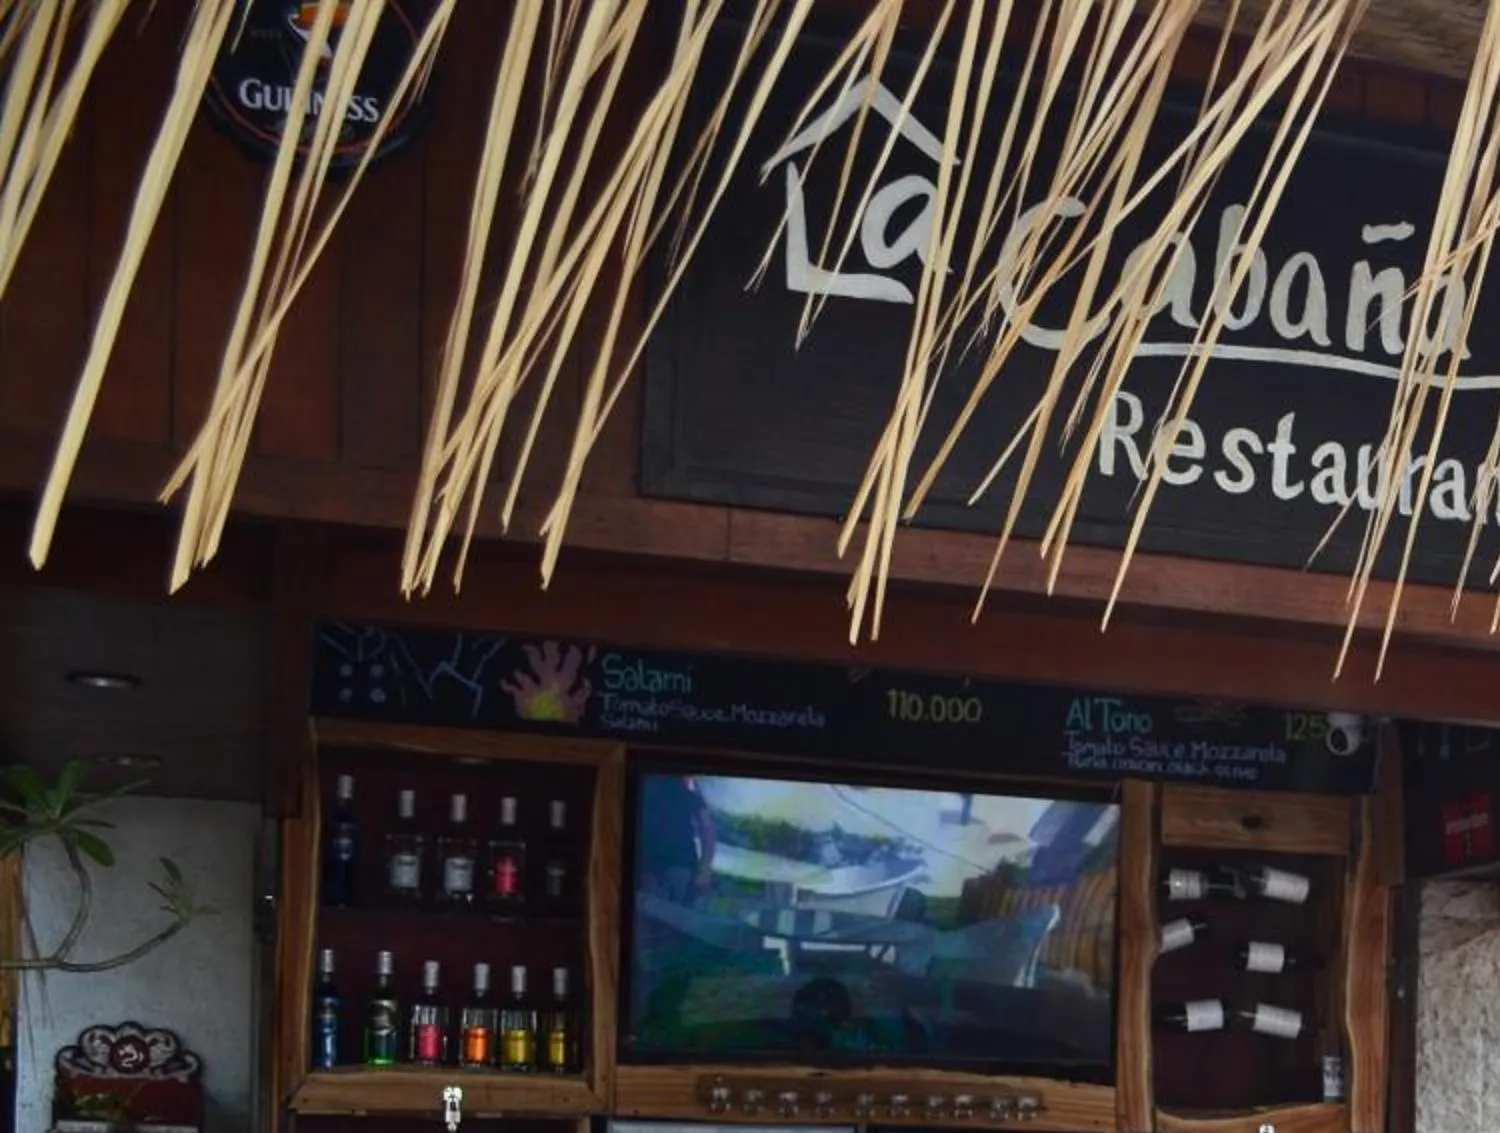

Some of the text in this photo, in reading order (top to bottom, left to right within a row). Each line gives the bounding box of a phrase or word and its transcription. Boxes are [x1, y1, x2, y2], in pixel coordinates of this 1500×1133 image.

[786, 160, 953, 305] La
[601, 652, 692, 694] Salami
[886, 688, 983, 723] 110.000
